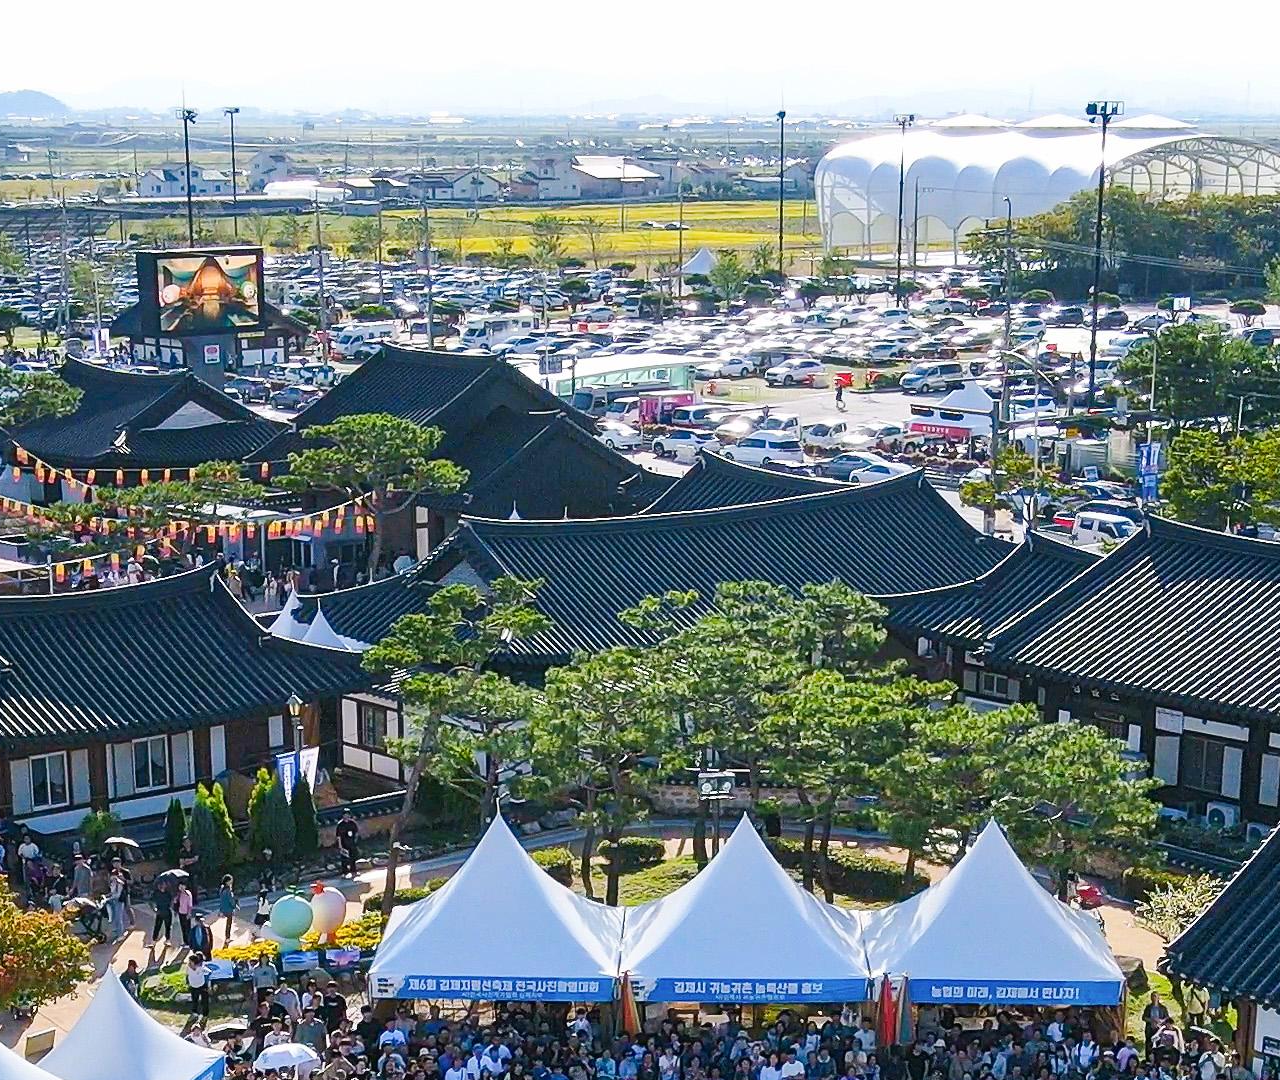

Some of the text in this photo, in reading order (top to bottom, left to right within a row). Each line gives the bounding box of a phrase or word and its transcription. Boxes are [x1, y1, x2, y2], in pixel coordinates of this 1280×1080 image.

[408, 978, 437, 991] 제6회
[439, 979, 513, 992] 김제지평선축제
[673, 982, 706, 994] 김제시
[709, 982, 754, 994] 귀농귀촌
[801, 983, 824, 994] 홍보
[1041, 986, 1080, 999] 만나자!
